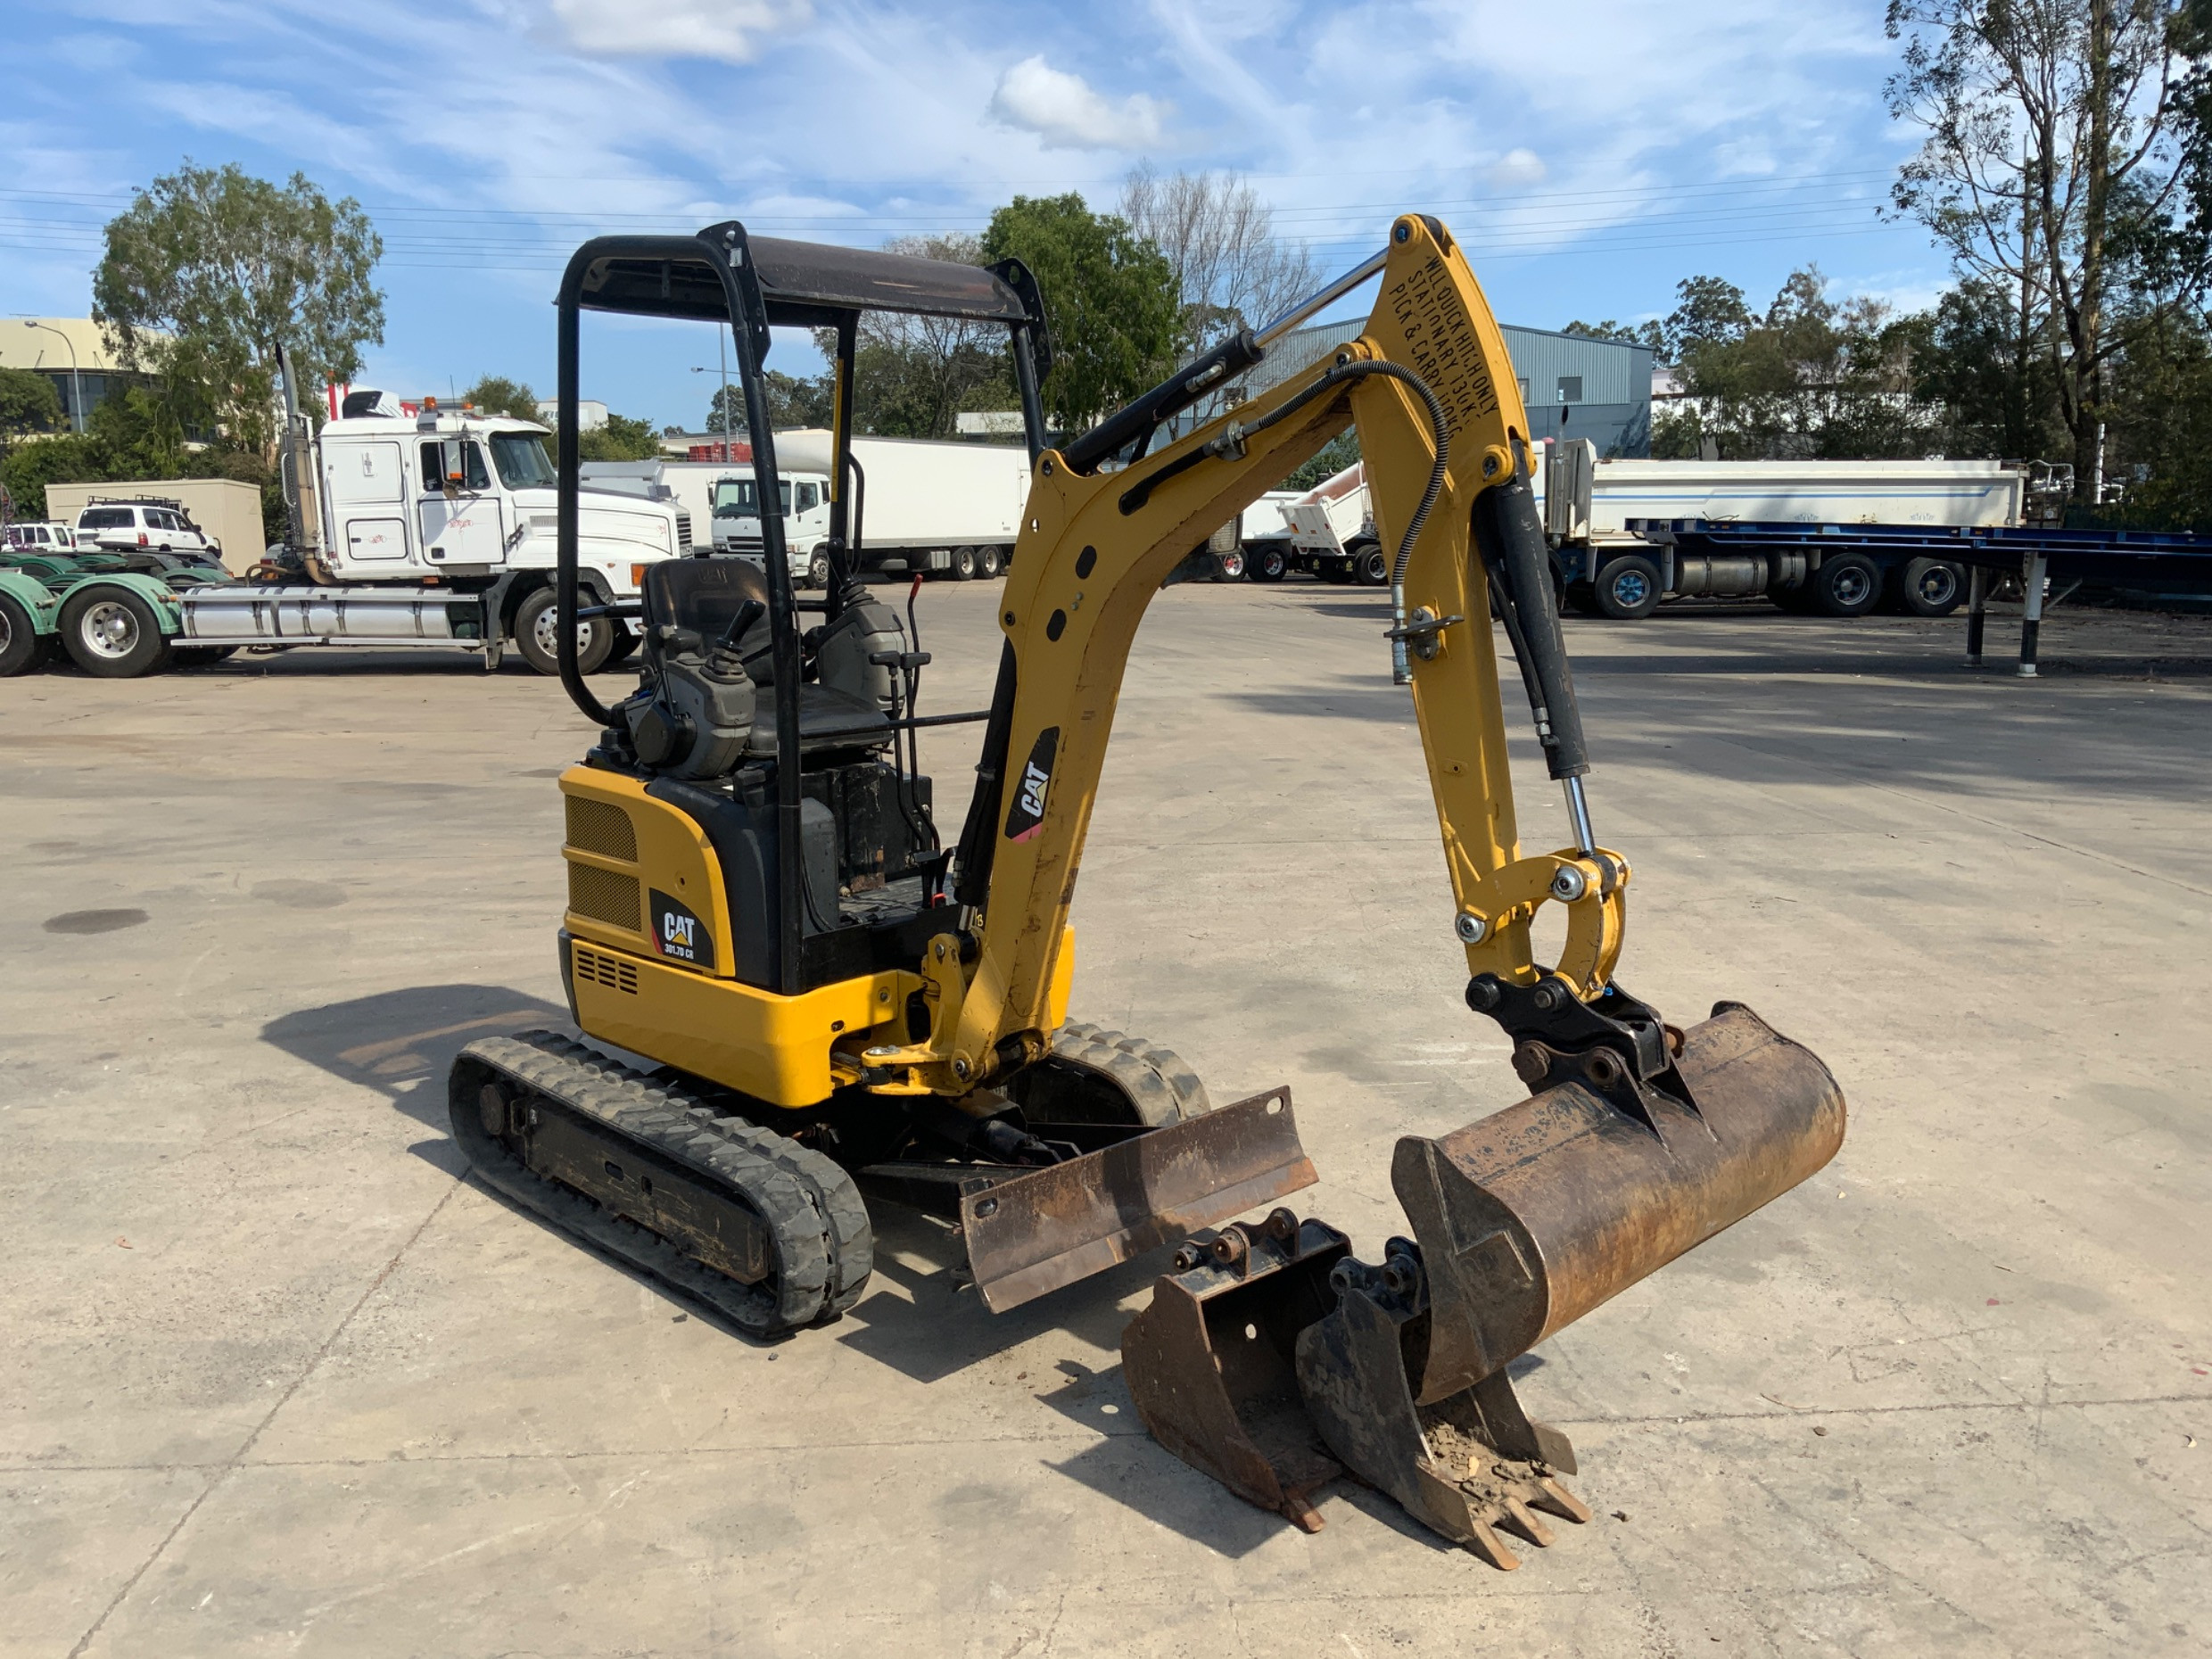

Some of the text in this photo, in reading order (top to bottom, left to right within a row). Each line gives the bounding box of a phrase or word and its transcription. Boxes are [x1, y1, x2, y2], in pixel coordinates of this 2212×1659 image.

[1389, 283, 1413, 325] PICK
[1407, 270, 1459, 371] STATIONARY
[1405, 323, 1422, 342] &
[1425, 256, 1446, 290] WLL
[1437, 286, 1467, 334] QUICK
[1473, 376, 1499, 416] ONLY
[1411, 340, 1445, 389] CARRY
[1020, 761, 1049, 818] CAT
[664, 912, 695, 947] CAT
[685, 948, 695, 960] CR
